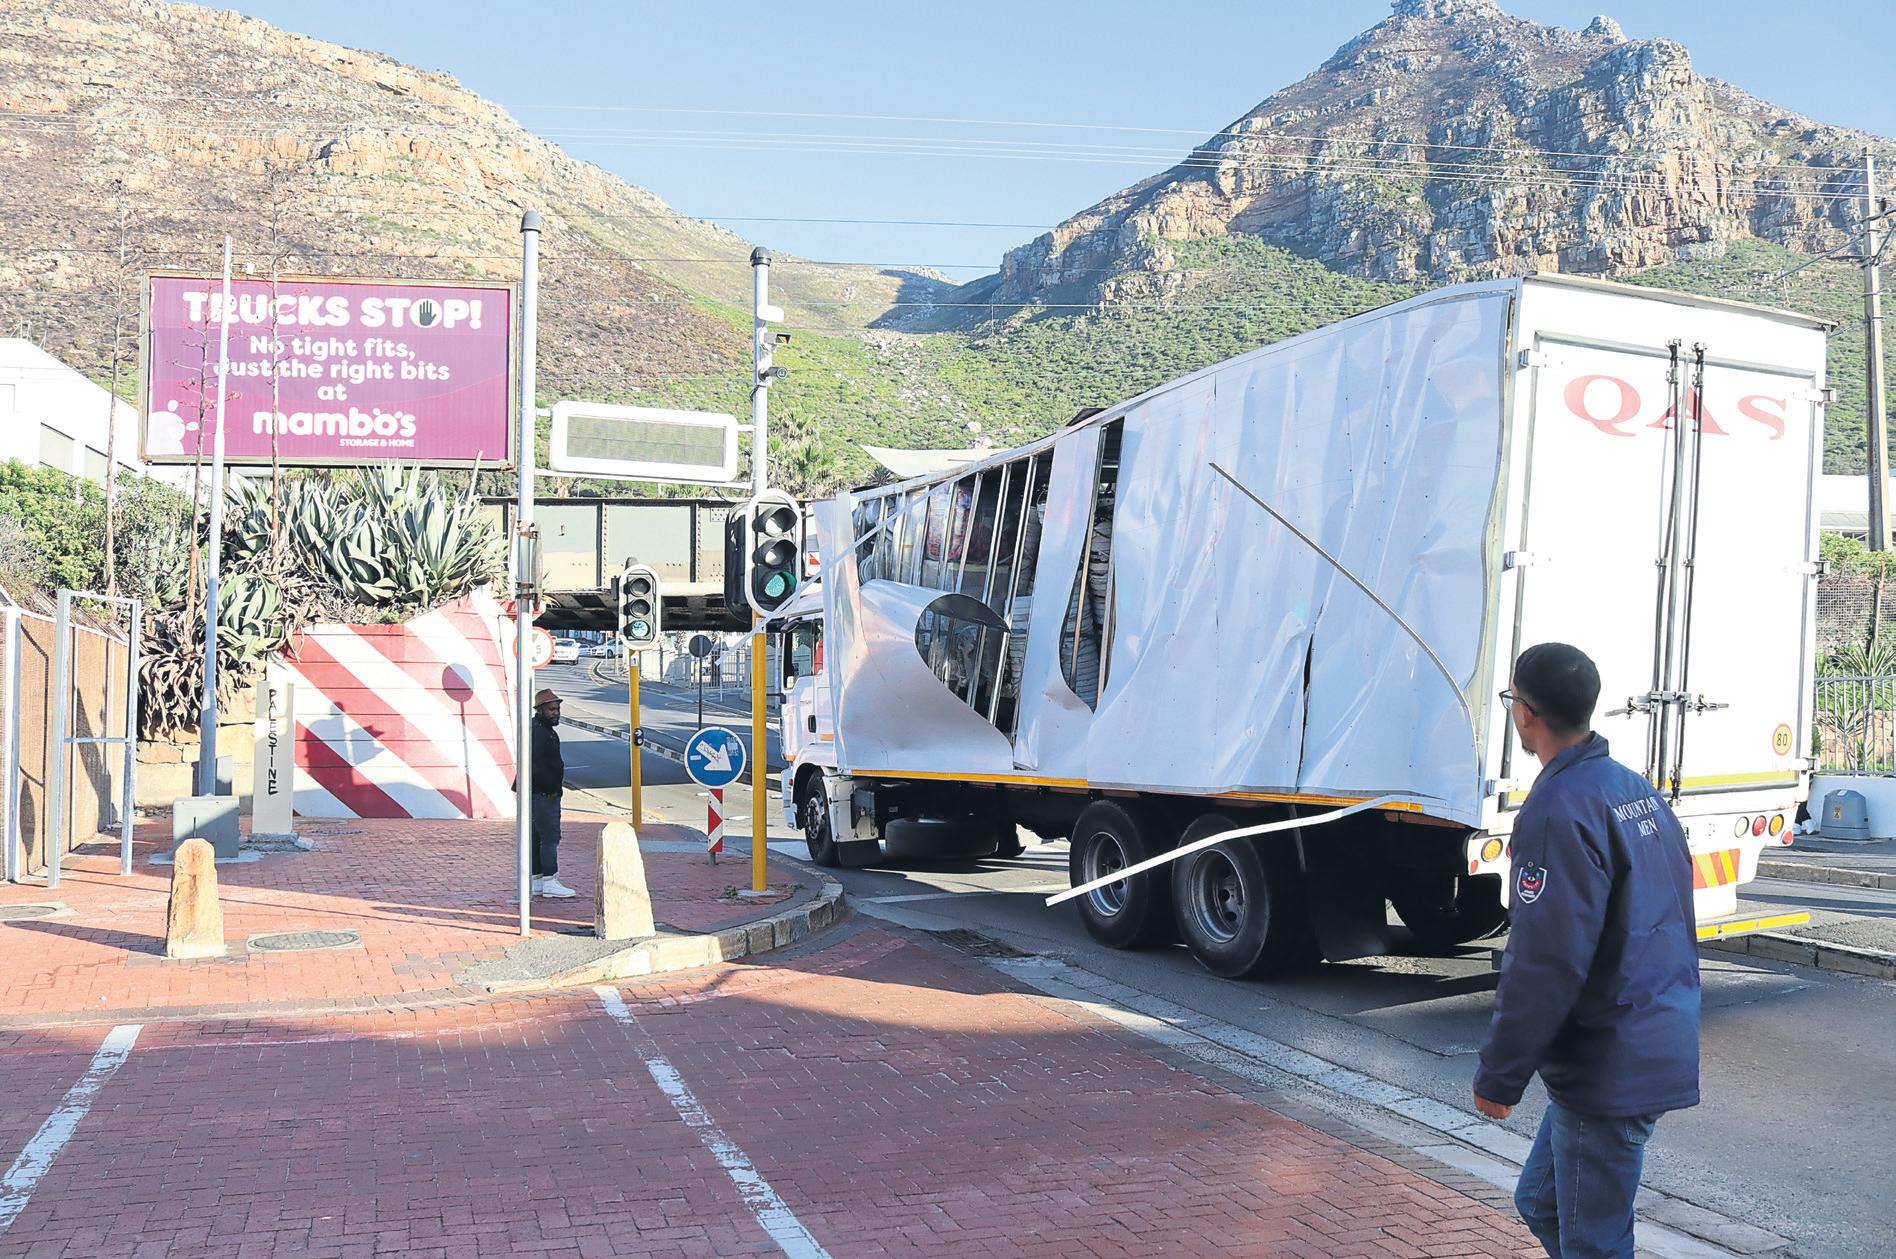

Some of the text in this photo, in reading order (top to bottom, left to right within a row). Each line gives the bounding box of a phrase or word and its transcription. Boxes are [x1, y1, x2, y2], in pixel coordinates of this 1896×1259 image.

[182, 291, 482, 329] TRUCKS STOP!
[250, 335, 415, 361] No tight fits,
[279, 358, 323, 378] the
[330, 360, 394, 384] right
[400, 360, 450, 380] bits
[317, 383, 347, 400] at
[1563, 374, 1787, 440] QAS
[339, 438, 379, 447] STORAGE
[388, 439, 414, 448] HOME
[268, 689, 278, 795] PALESTINE
[1776, 733, 1788, 746] 80
[1637, 817, 1658, 837] MEN
